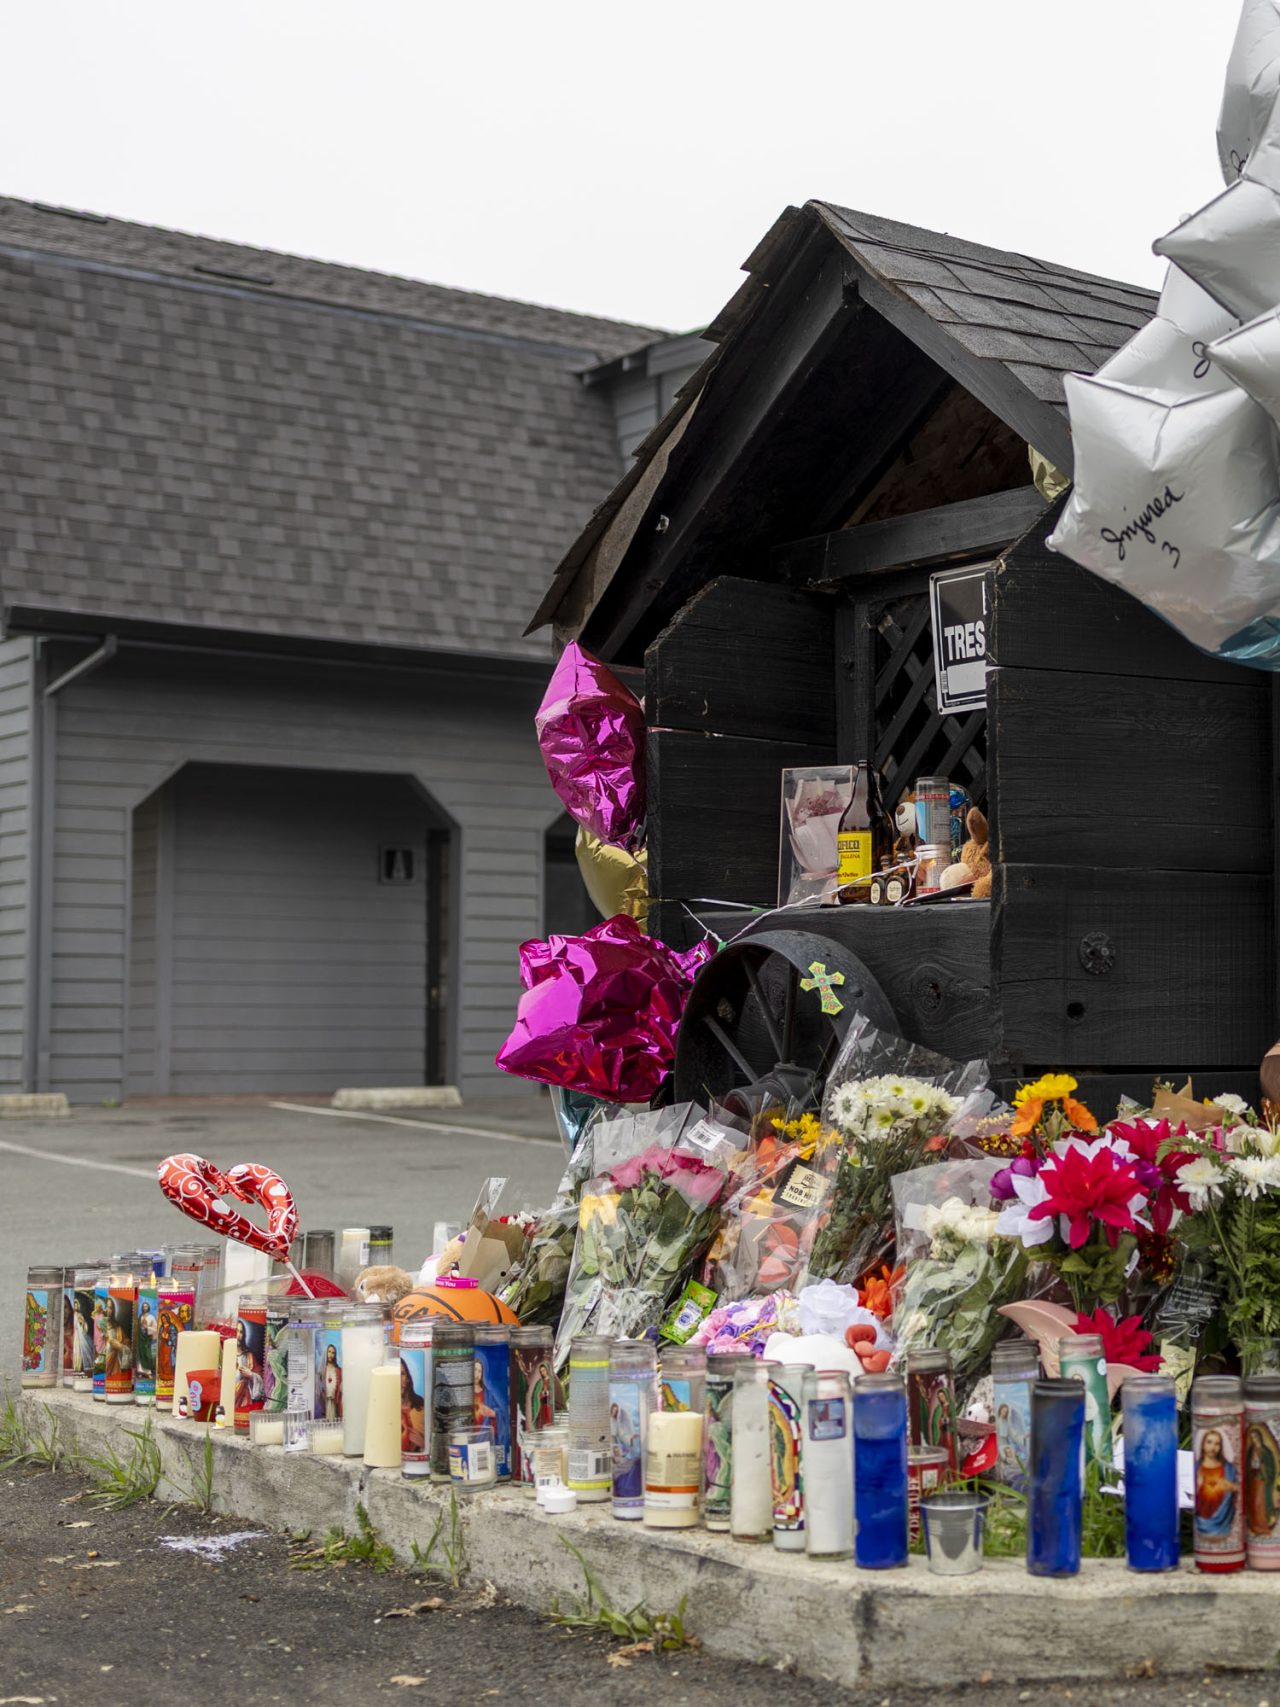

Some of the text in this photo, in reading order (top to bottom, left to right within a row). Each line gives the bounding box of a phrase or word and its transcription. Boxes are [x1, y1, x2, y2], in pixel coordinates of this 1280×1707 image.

[1100, 485, 1186, 562] Injured
[1161, 540, 1181, 570] 3
[944, 620, 986, 661] TRES
